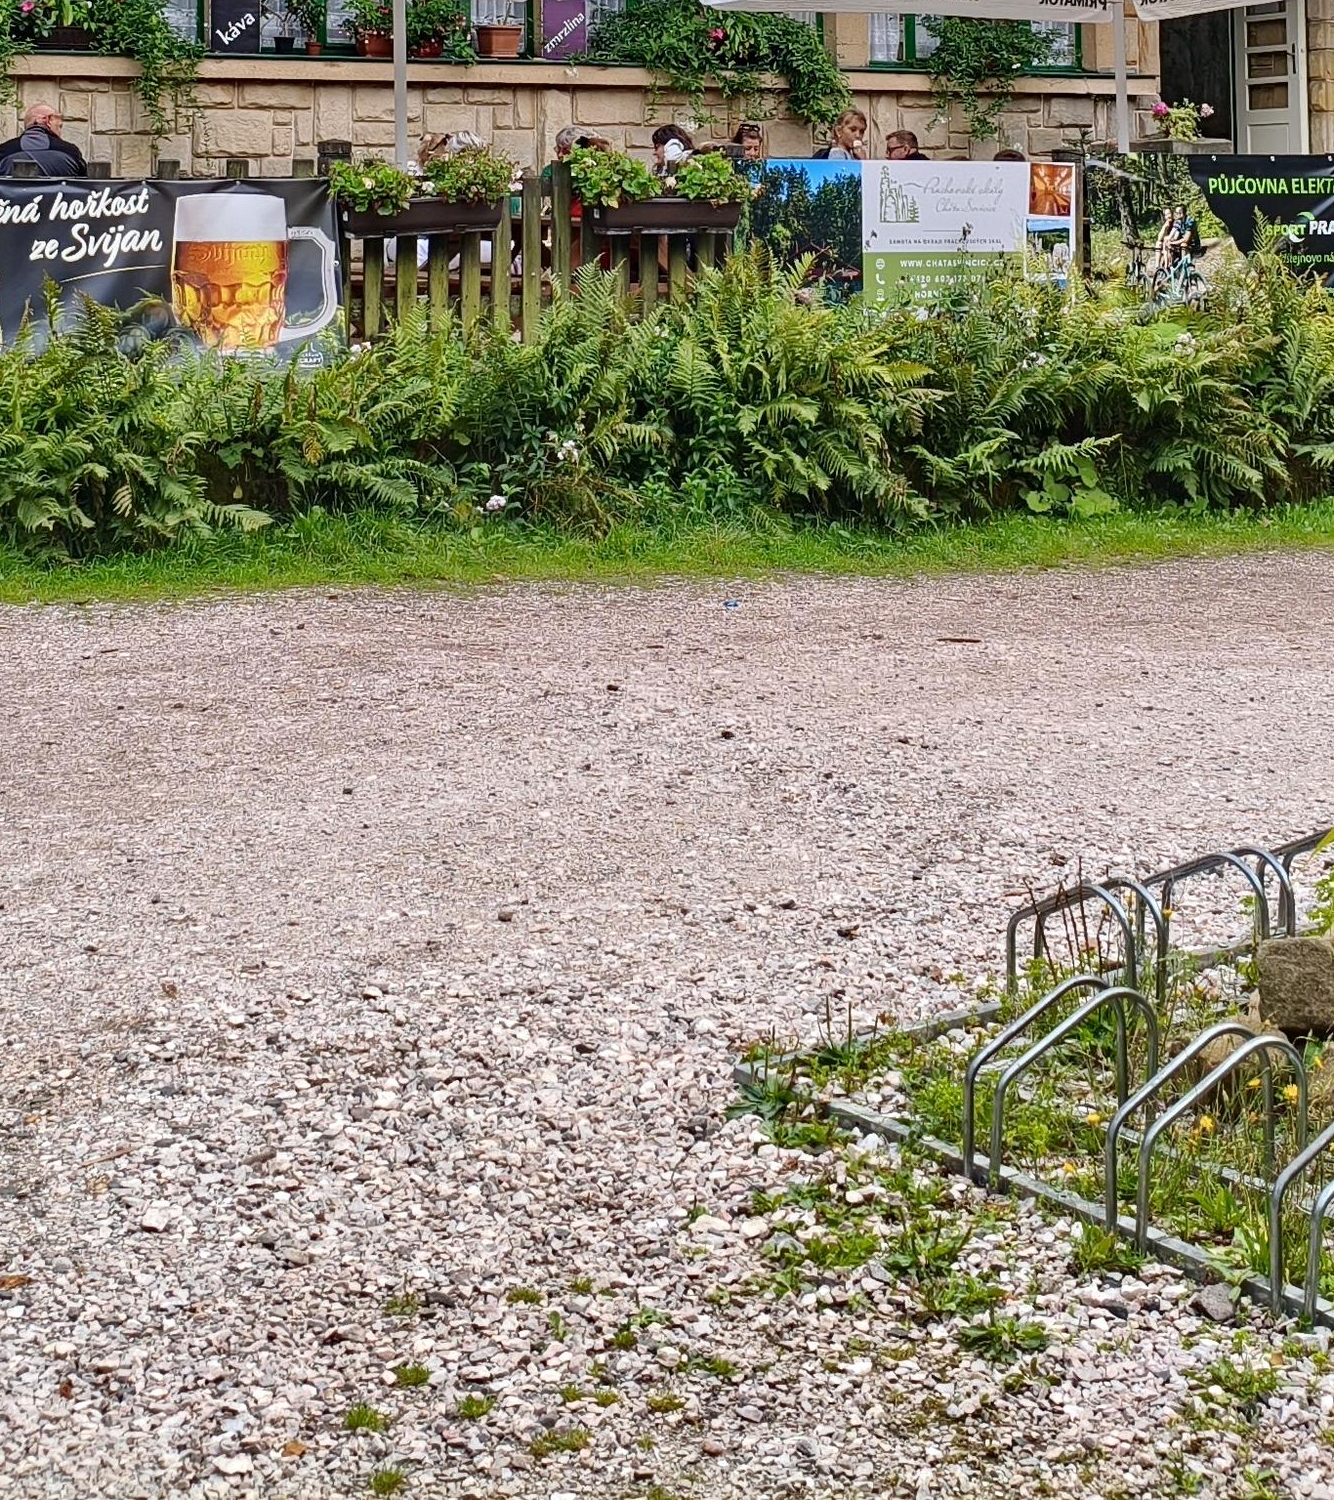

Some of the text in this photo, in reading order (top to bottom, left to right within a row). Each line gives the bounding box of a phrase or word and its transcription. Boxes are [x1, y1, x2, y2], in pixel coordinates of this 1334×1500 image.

[215, 11, 257, 45] káva
[543, 11, 586, 53] zmrzlina
[1208, 173, 1288, 194] PŮJČOVNA
[49, 187, 149, 221] hořkost
[29, 223, 163, 268] ze Svijan
